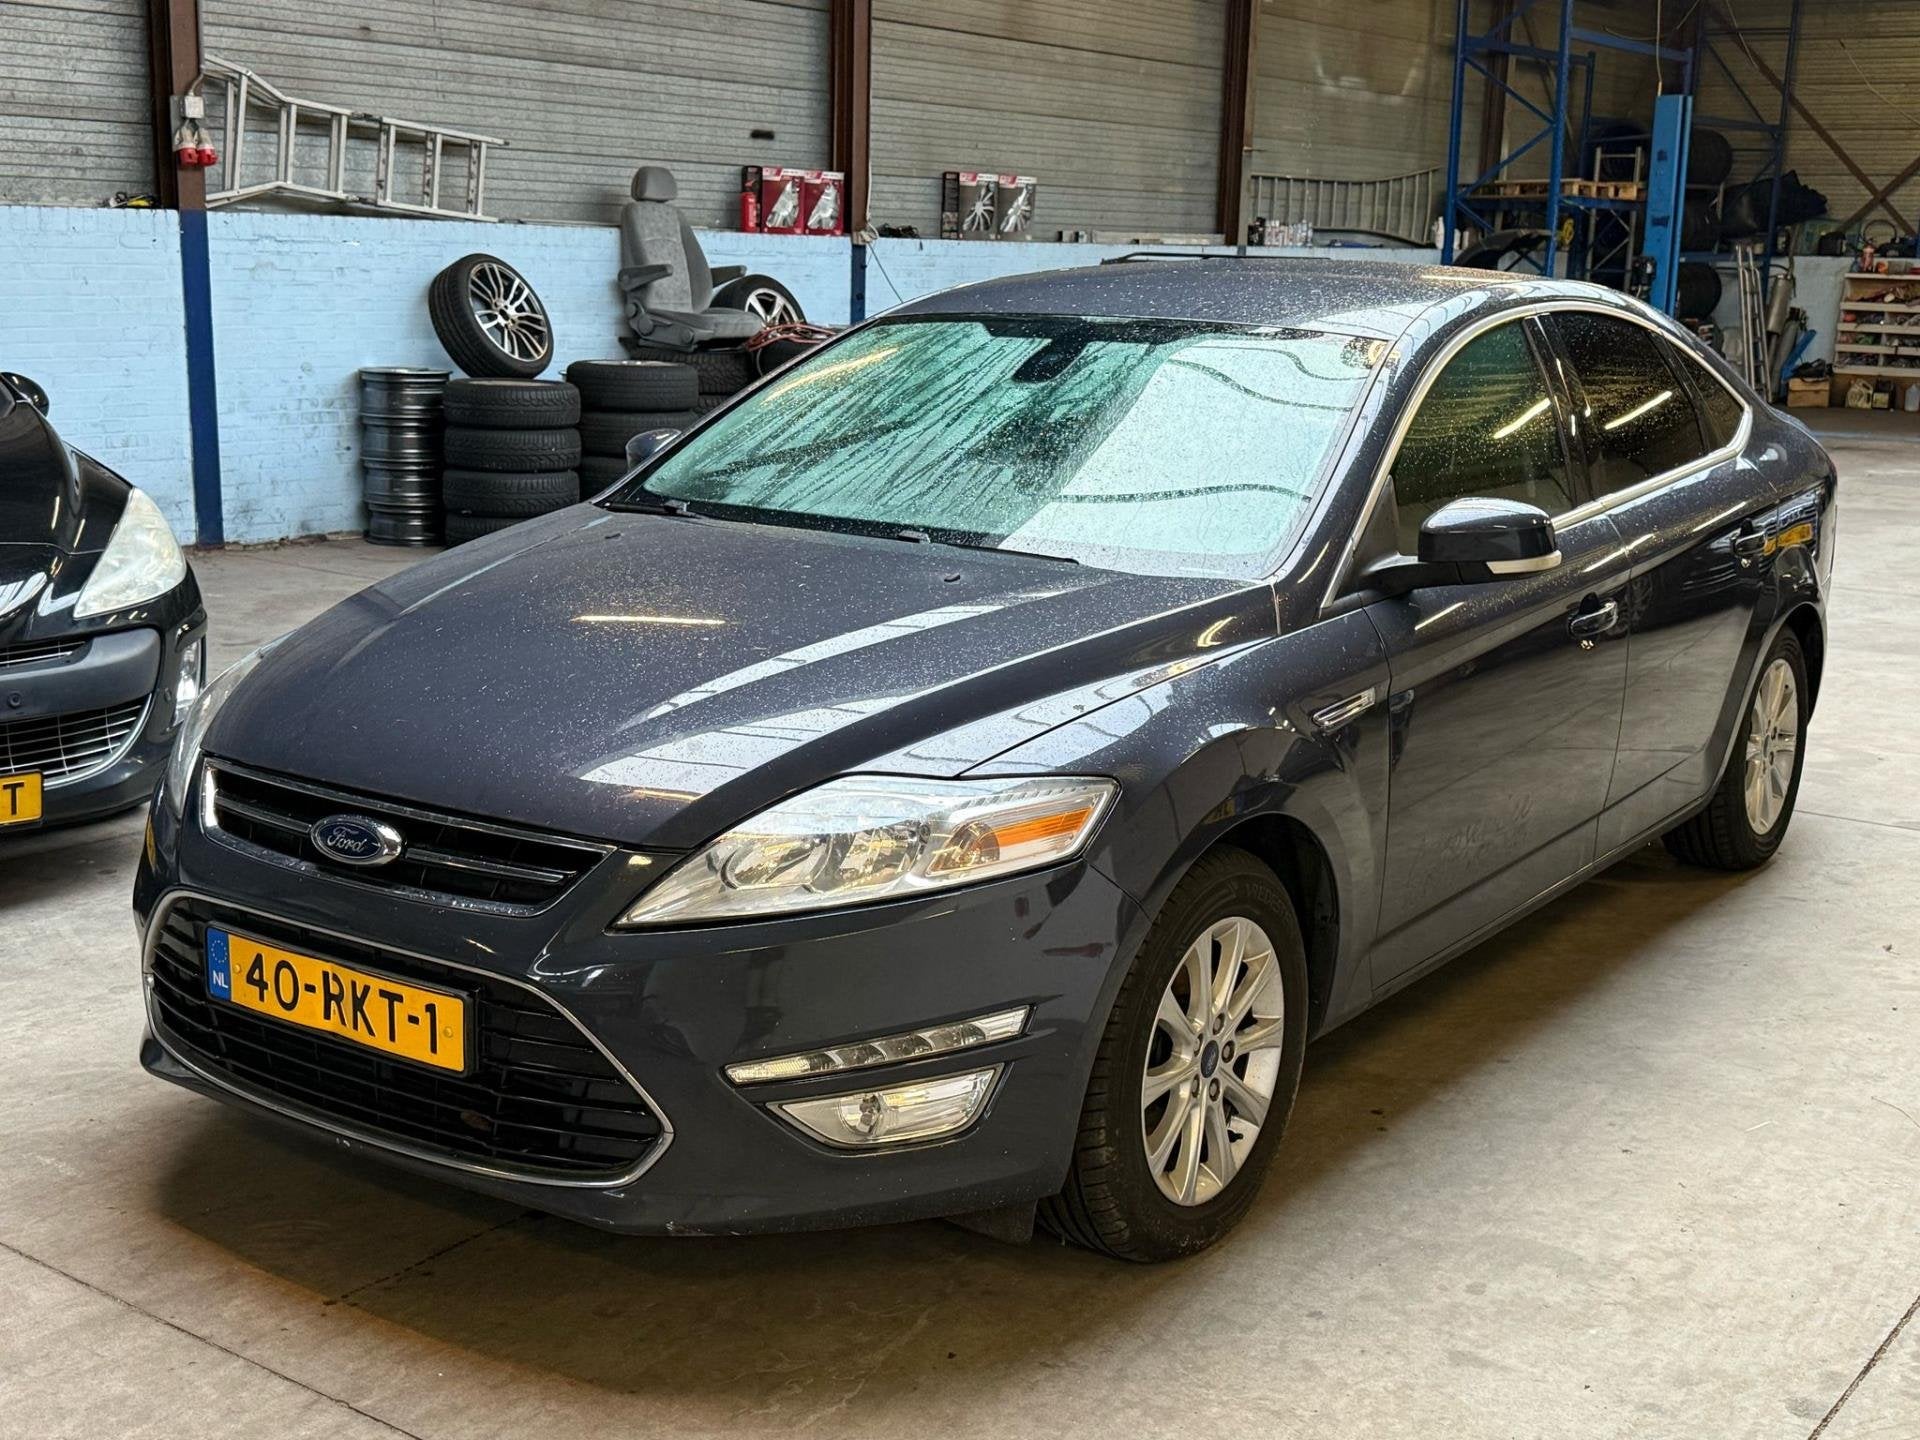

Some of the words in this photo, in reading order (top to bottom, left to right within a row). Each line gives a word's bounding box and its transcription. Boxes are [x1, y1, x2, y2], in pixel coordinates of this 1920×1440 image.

[2, 781, 25, 816] T
[327, 826, 368, 852] Ford
[212, 969, 229, 989] NL
[246, 953, 438, 1054] 40-RKT-1
